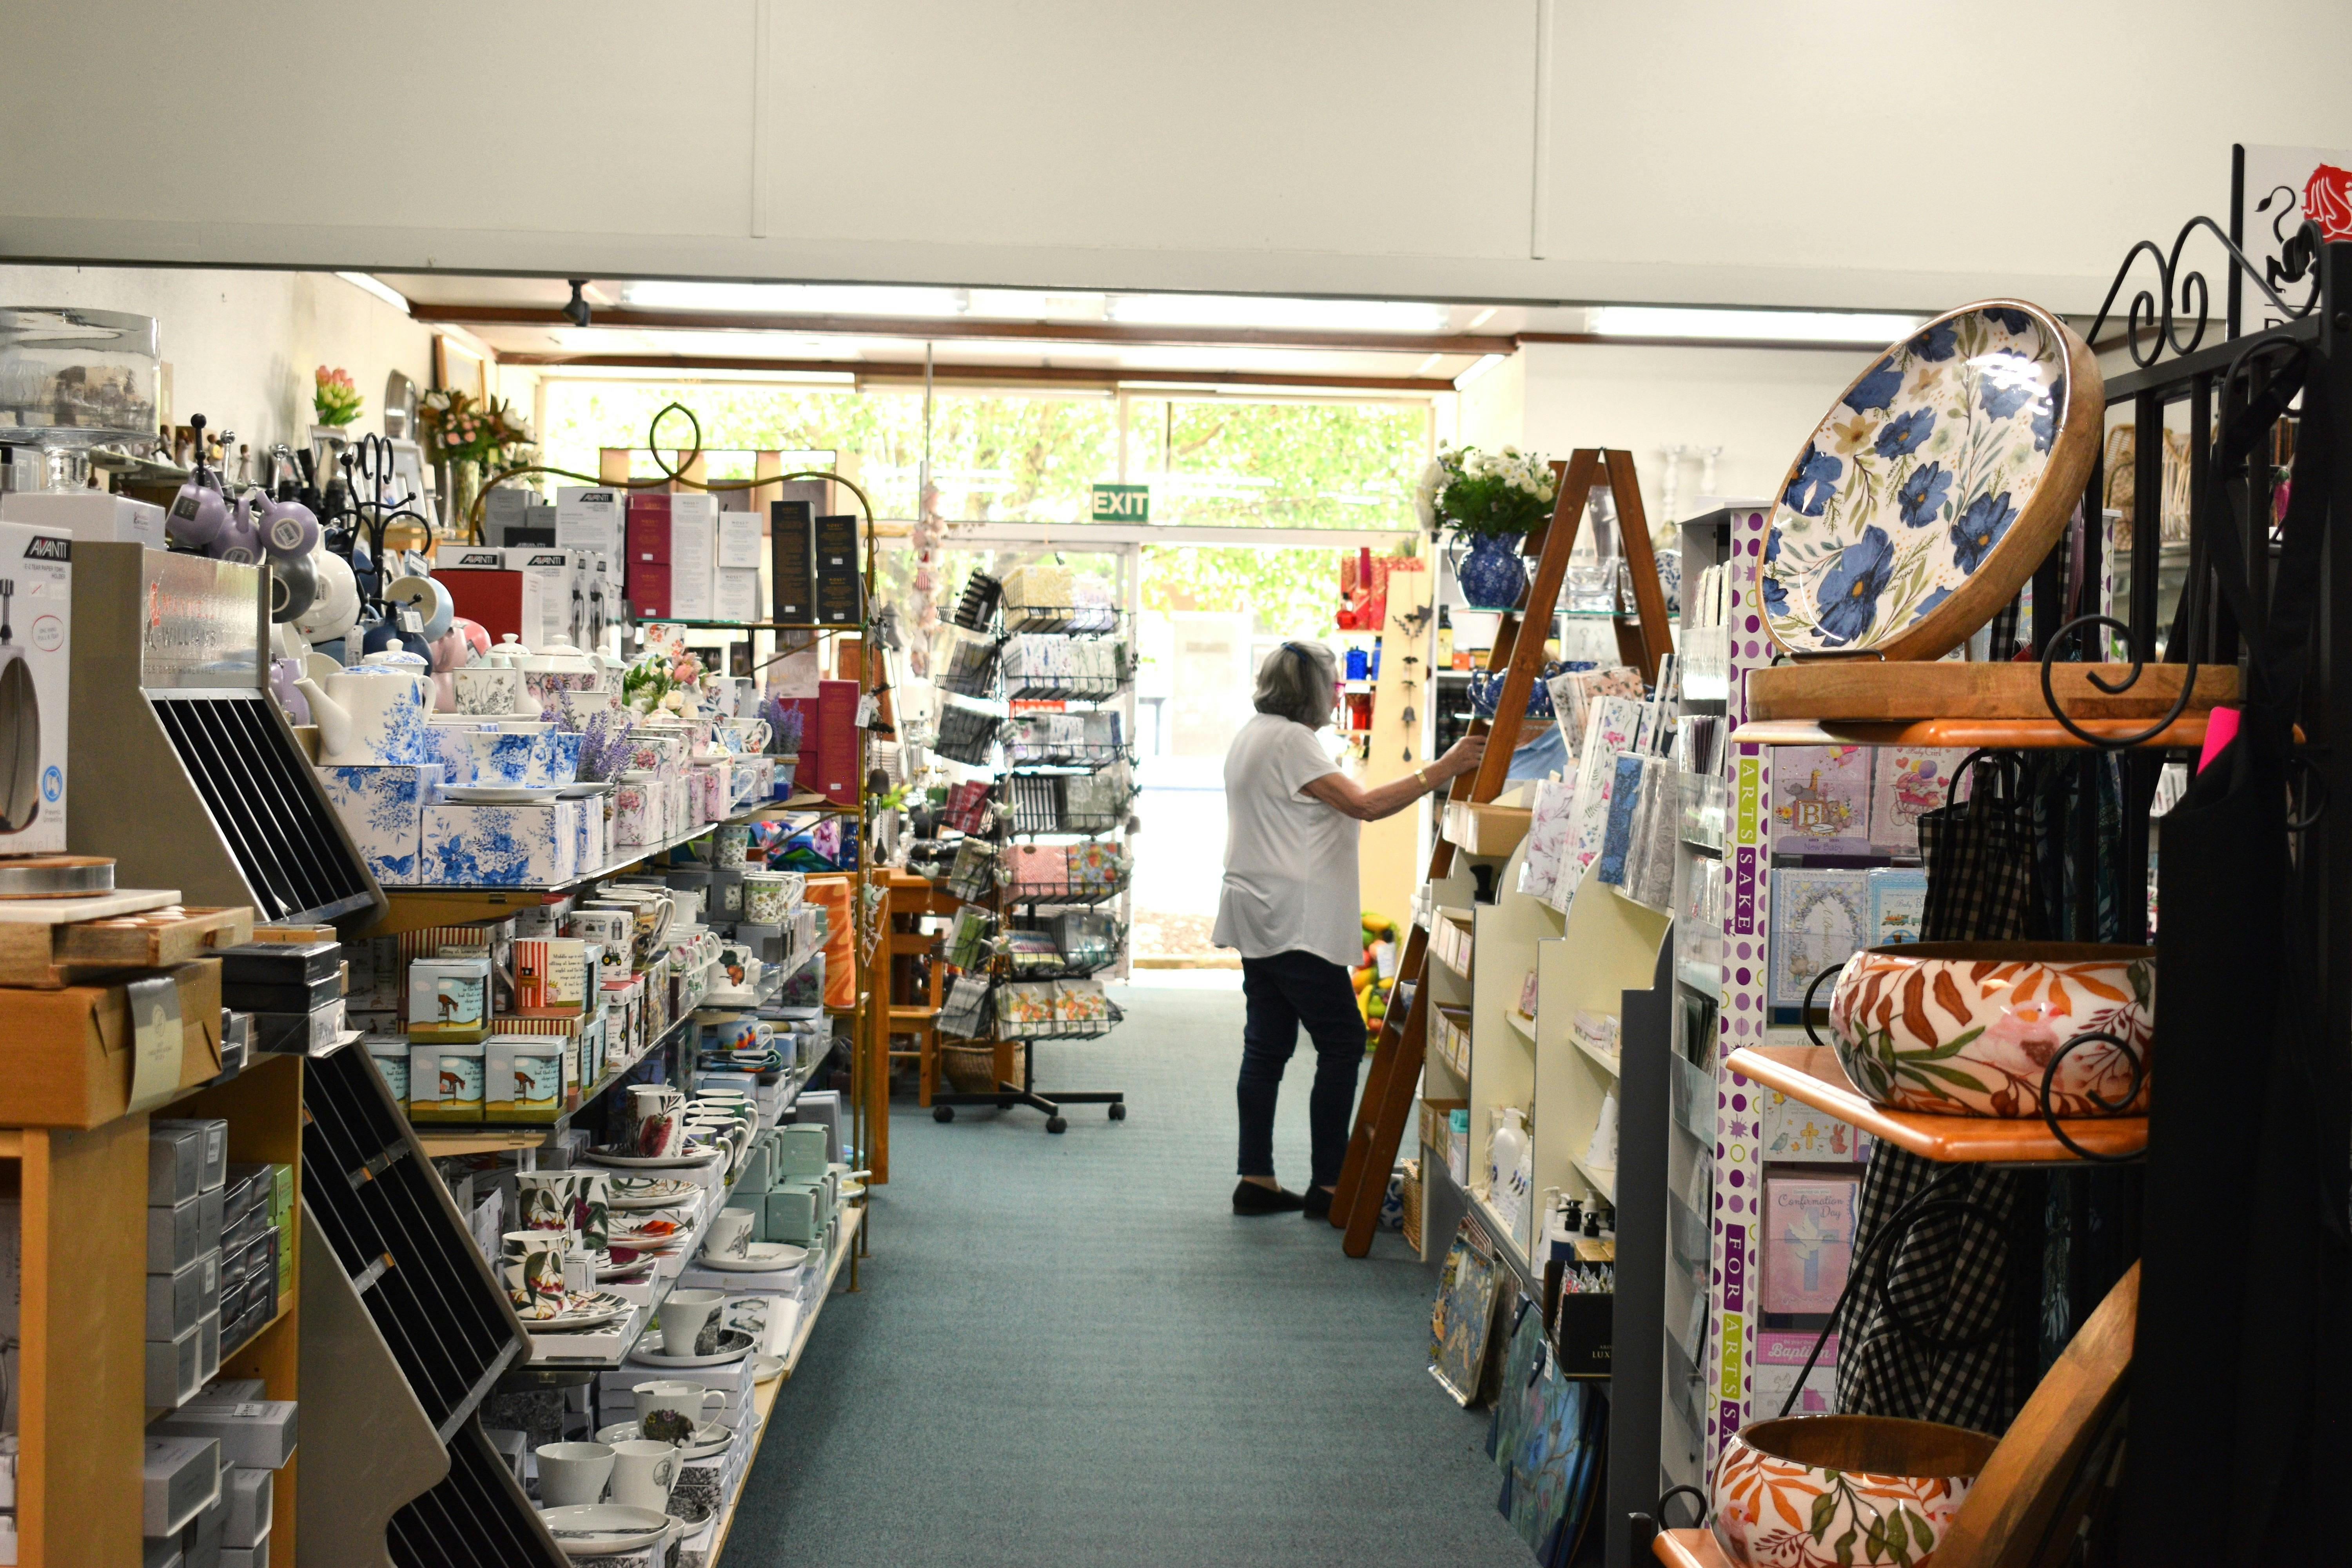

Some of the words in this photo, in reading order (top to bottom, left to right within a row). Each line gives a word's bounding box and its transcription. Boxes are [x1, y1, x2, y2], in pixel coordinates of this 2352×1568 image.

[1093, 491, 1148, 515] EXIT
[30, 539, 67, 558] AVANTI
[463, 555, 492, 564] AVANTI
[1925, 746, 1941, 756] Girl
[1741, 764, 1755, 839] ARTS
[1823, 843, 1844, 853] Baby
[1738, 853, 1753, 928] SAKE
[1778, 1194, 1844, 1210] Confirmation
[1820, 1205, 1841, 1221] Day
[1727, 1237, 1741, 1299] FOR
[1724, 1318, 1739, 1394] ARTS
[1768, 1342, 1830, 1360] Baptim
